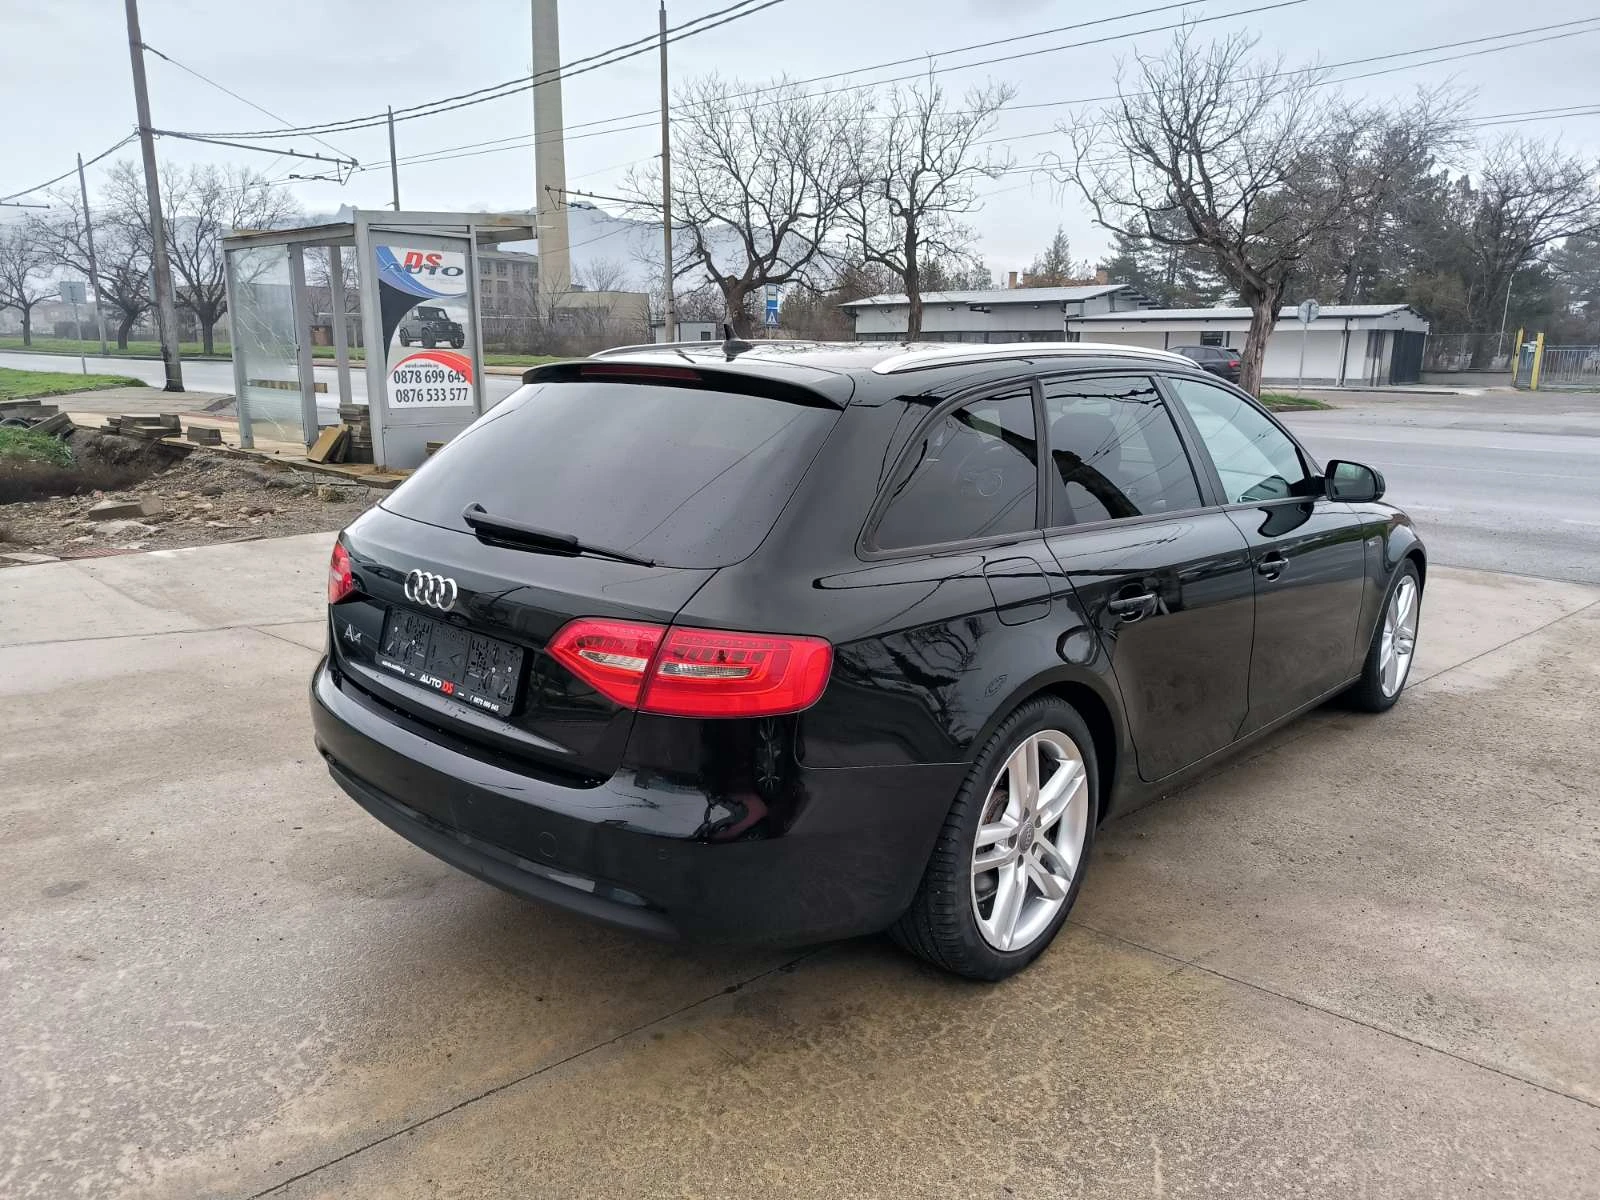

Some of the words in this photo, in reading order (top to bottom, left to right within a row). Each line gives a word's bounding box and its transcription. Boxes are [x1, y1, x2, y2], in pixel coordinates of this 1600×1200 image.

[404, 252, 442, 268] DS
[394, 370, 422, 384] 0878
[425, 370, 445, 383] 699
[448, 370, 467, 383] 645
[396, 388, 424, 402] 0876
[426, 388, 446, 401] 533
[449, 387, 468, 401] 577
[344, 624, 362, 643] A4
[420, 674, 442, 688] AUTO
[441, 680, 455, 694] DS
